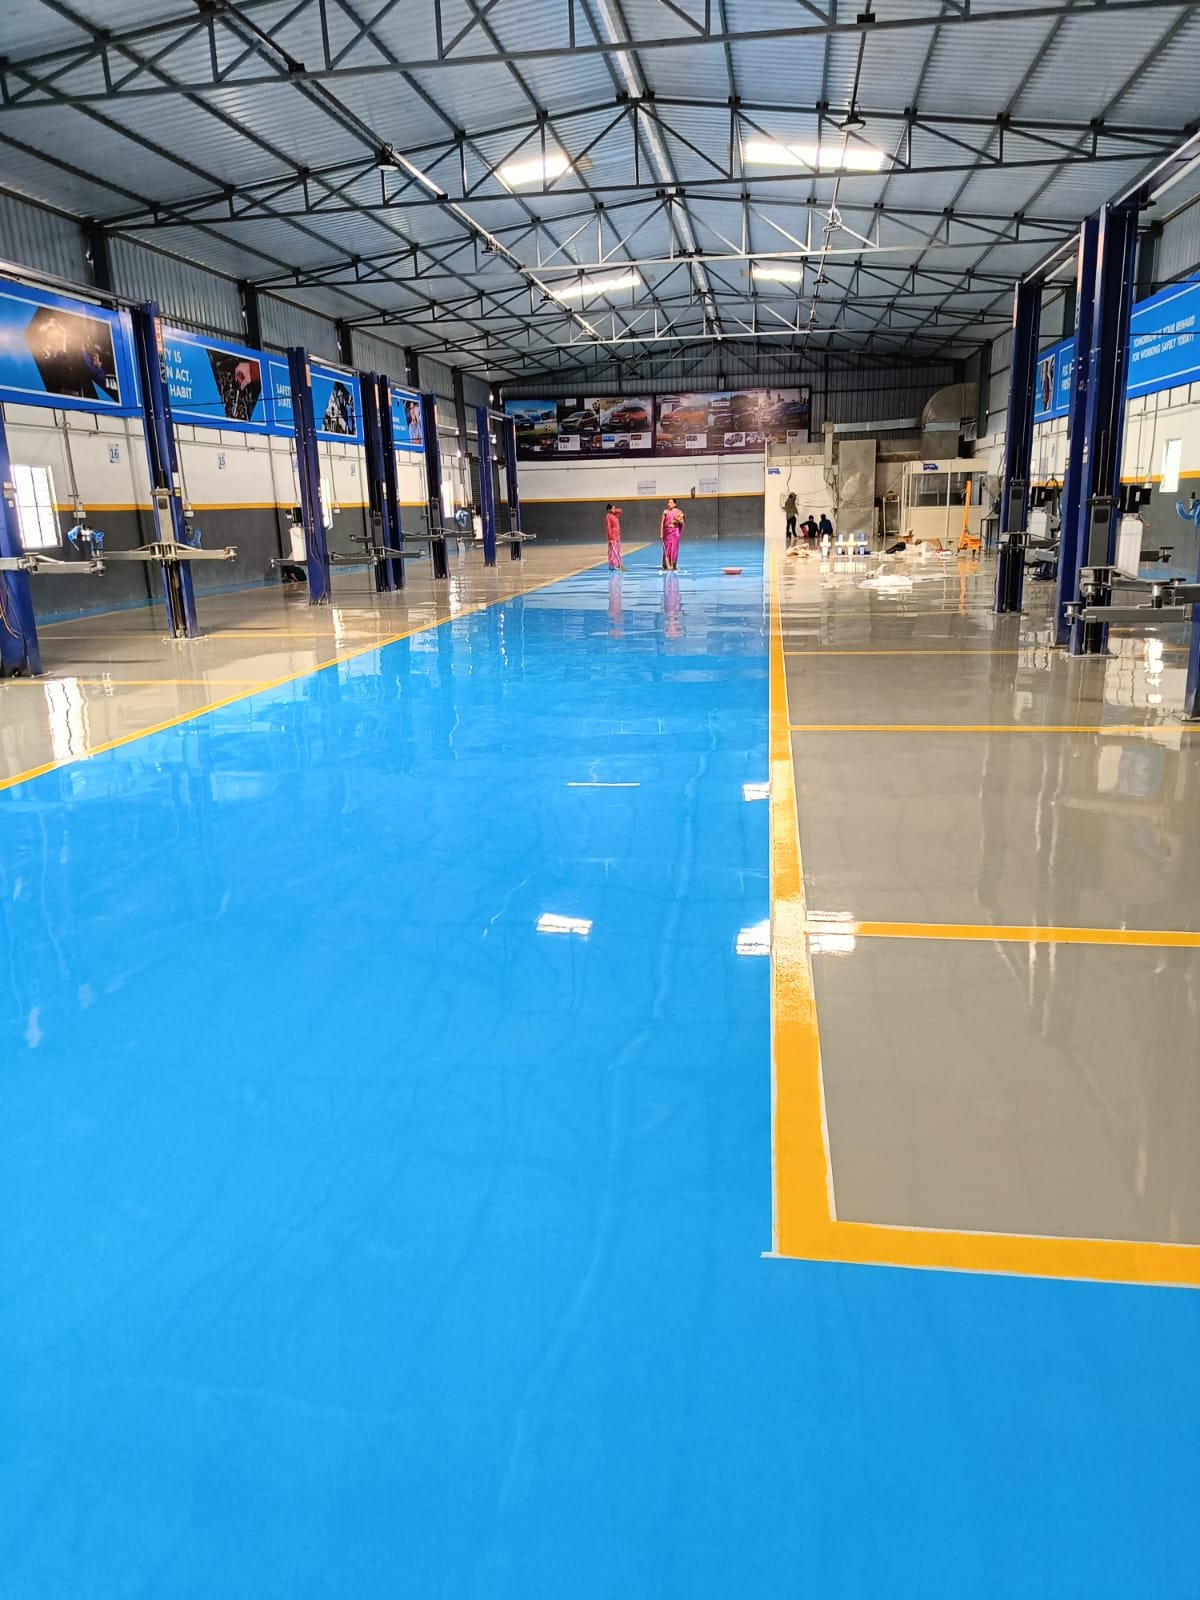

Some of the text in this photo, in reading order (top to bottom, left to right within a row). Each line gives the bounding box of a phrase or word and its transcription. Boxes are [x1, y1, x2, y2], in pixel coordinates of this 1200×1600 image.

[174, 350, 182, 364] IS
[175, 368, 192, 384] ACT,
[169, 384, 192, 400] HABIT
[276, 384, 292, 397] SAFET
[110, 448, 120, 459] 16
[218, 456, 226, 466] 15
